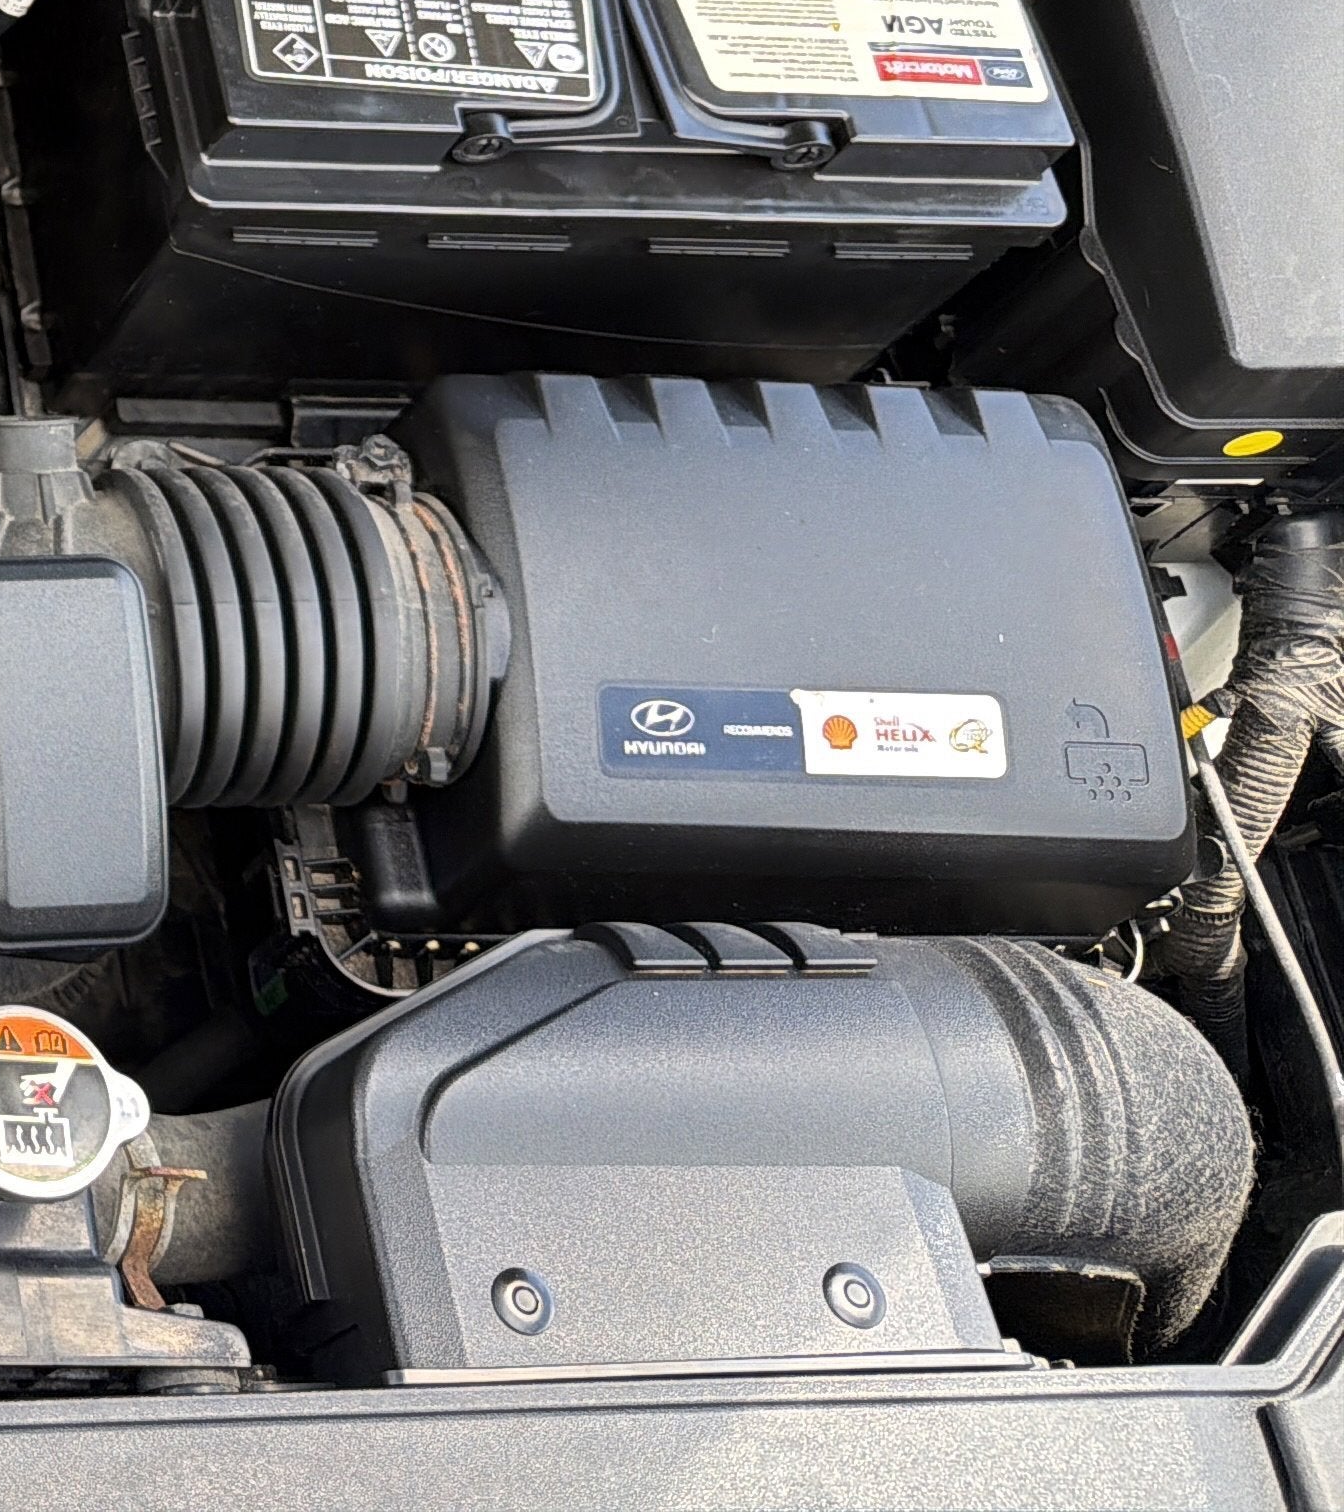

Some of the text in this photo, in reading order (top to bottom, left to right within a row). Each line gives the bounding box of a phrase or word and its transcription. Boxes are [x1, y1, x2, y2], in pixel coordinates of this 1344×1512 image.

[365, 64, 535, 91] DANGER/POISON
[882, 60, 973, 80] Motorcraft
[875, 727, 935, 743] HELIX
[623, 740, 706, 756] HYUNDAI
